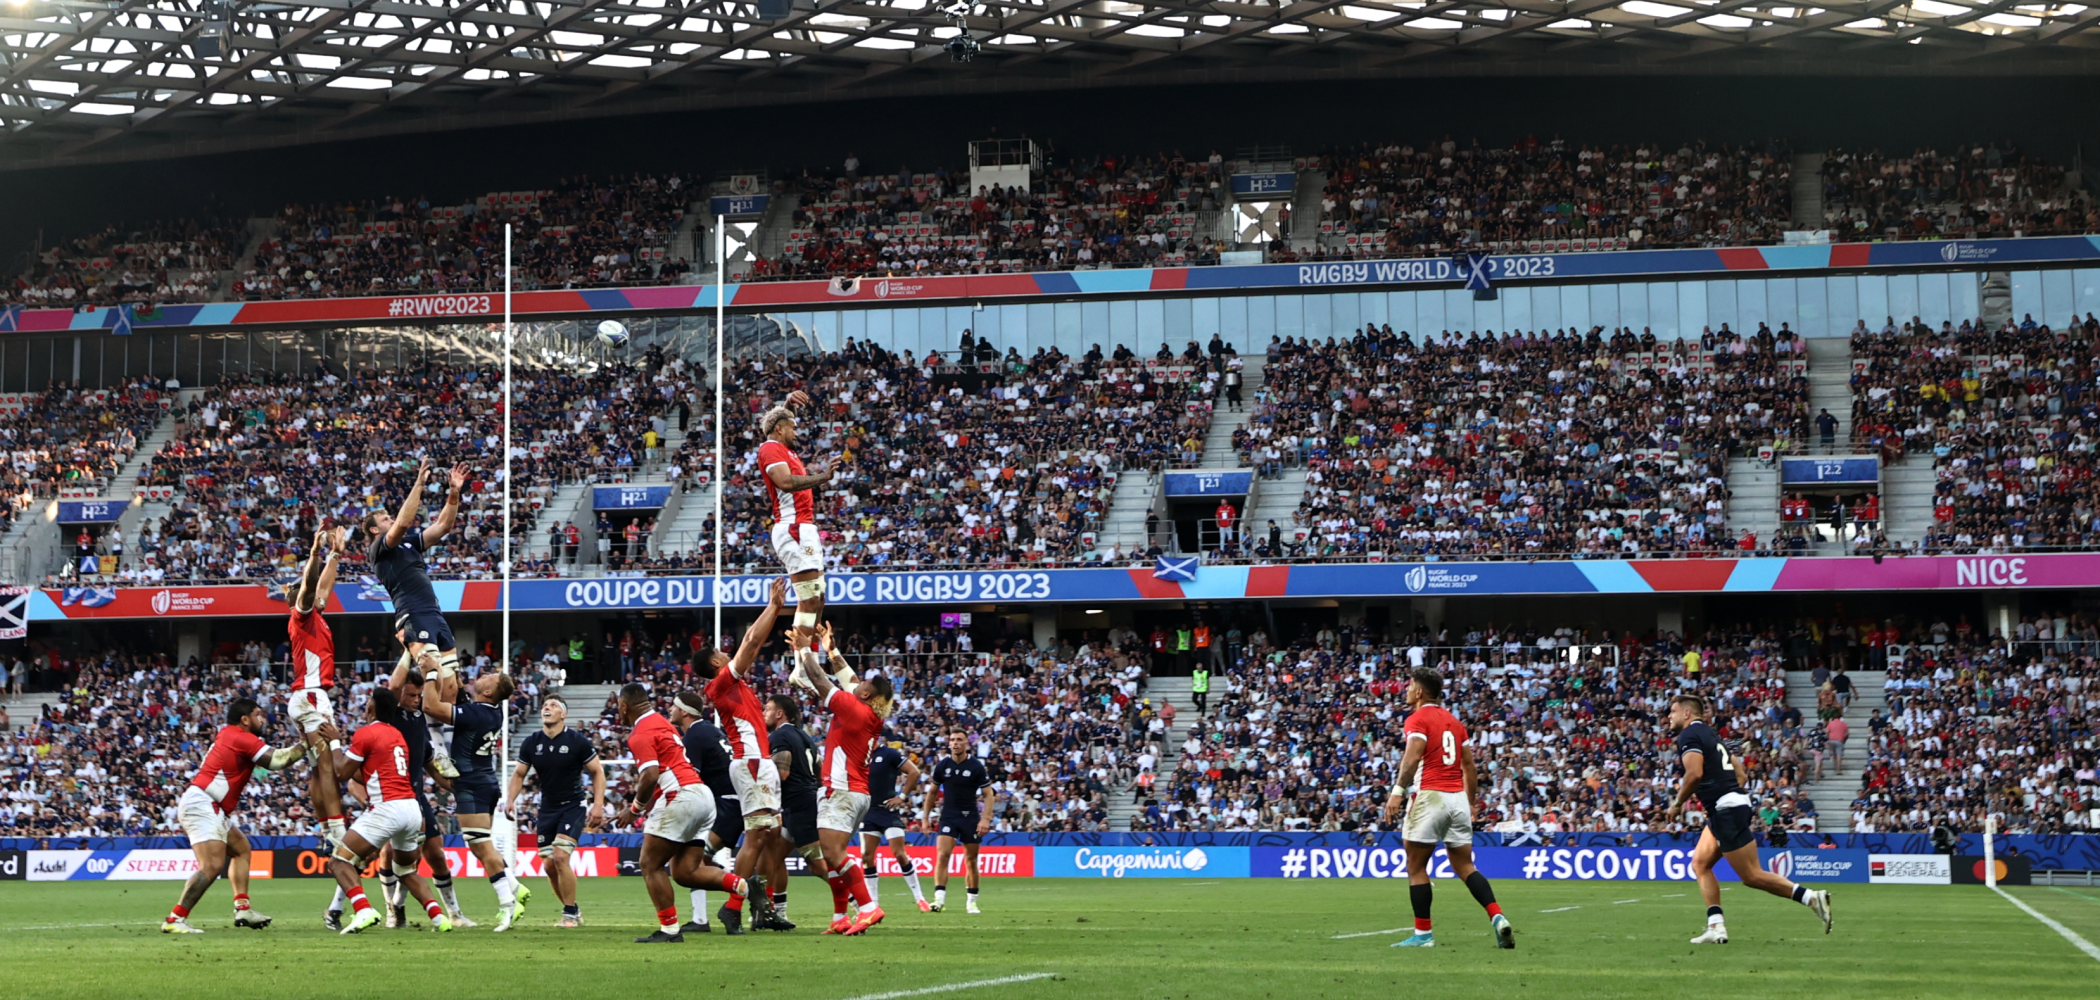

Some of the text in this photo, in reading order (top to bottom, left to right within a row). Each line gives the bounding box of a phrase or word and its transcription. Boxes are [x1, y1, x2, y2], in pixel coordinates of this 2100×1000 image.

[1300, 257, 1555, 284] RUGBY WORLD CP 2023
[388, 296, 490, 316] #RWC2023
[621, 492, 647, 506] H2.1
[82, 505, 109, 519] H2.2
[1460, 574, 1478, 582] CUP
[1956, 558, 2028, 586] NICE
[666, 579, 704, 605] DU
[876, 574, 972, 602] RUGBY
[979, 572, 1050, 600] 2023
[1442, 730, 1457, 766] 9
[393, 745, 408, 777] 6
[0, 855, 18, 875] d
[126, 859, 177, 872] SUPER
[947, 853, 964, 873] LY
[1075, 848, 1183, 878] Capgemini
[1795, 862, 1832, 870] WORLD
